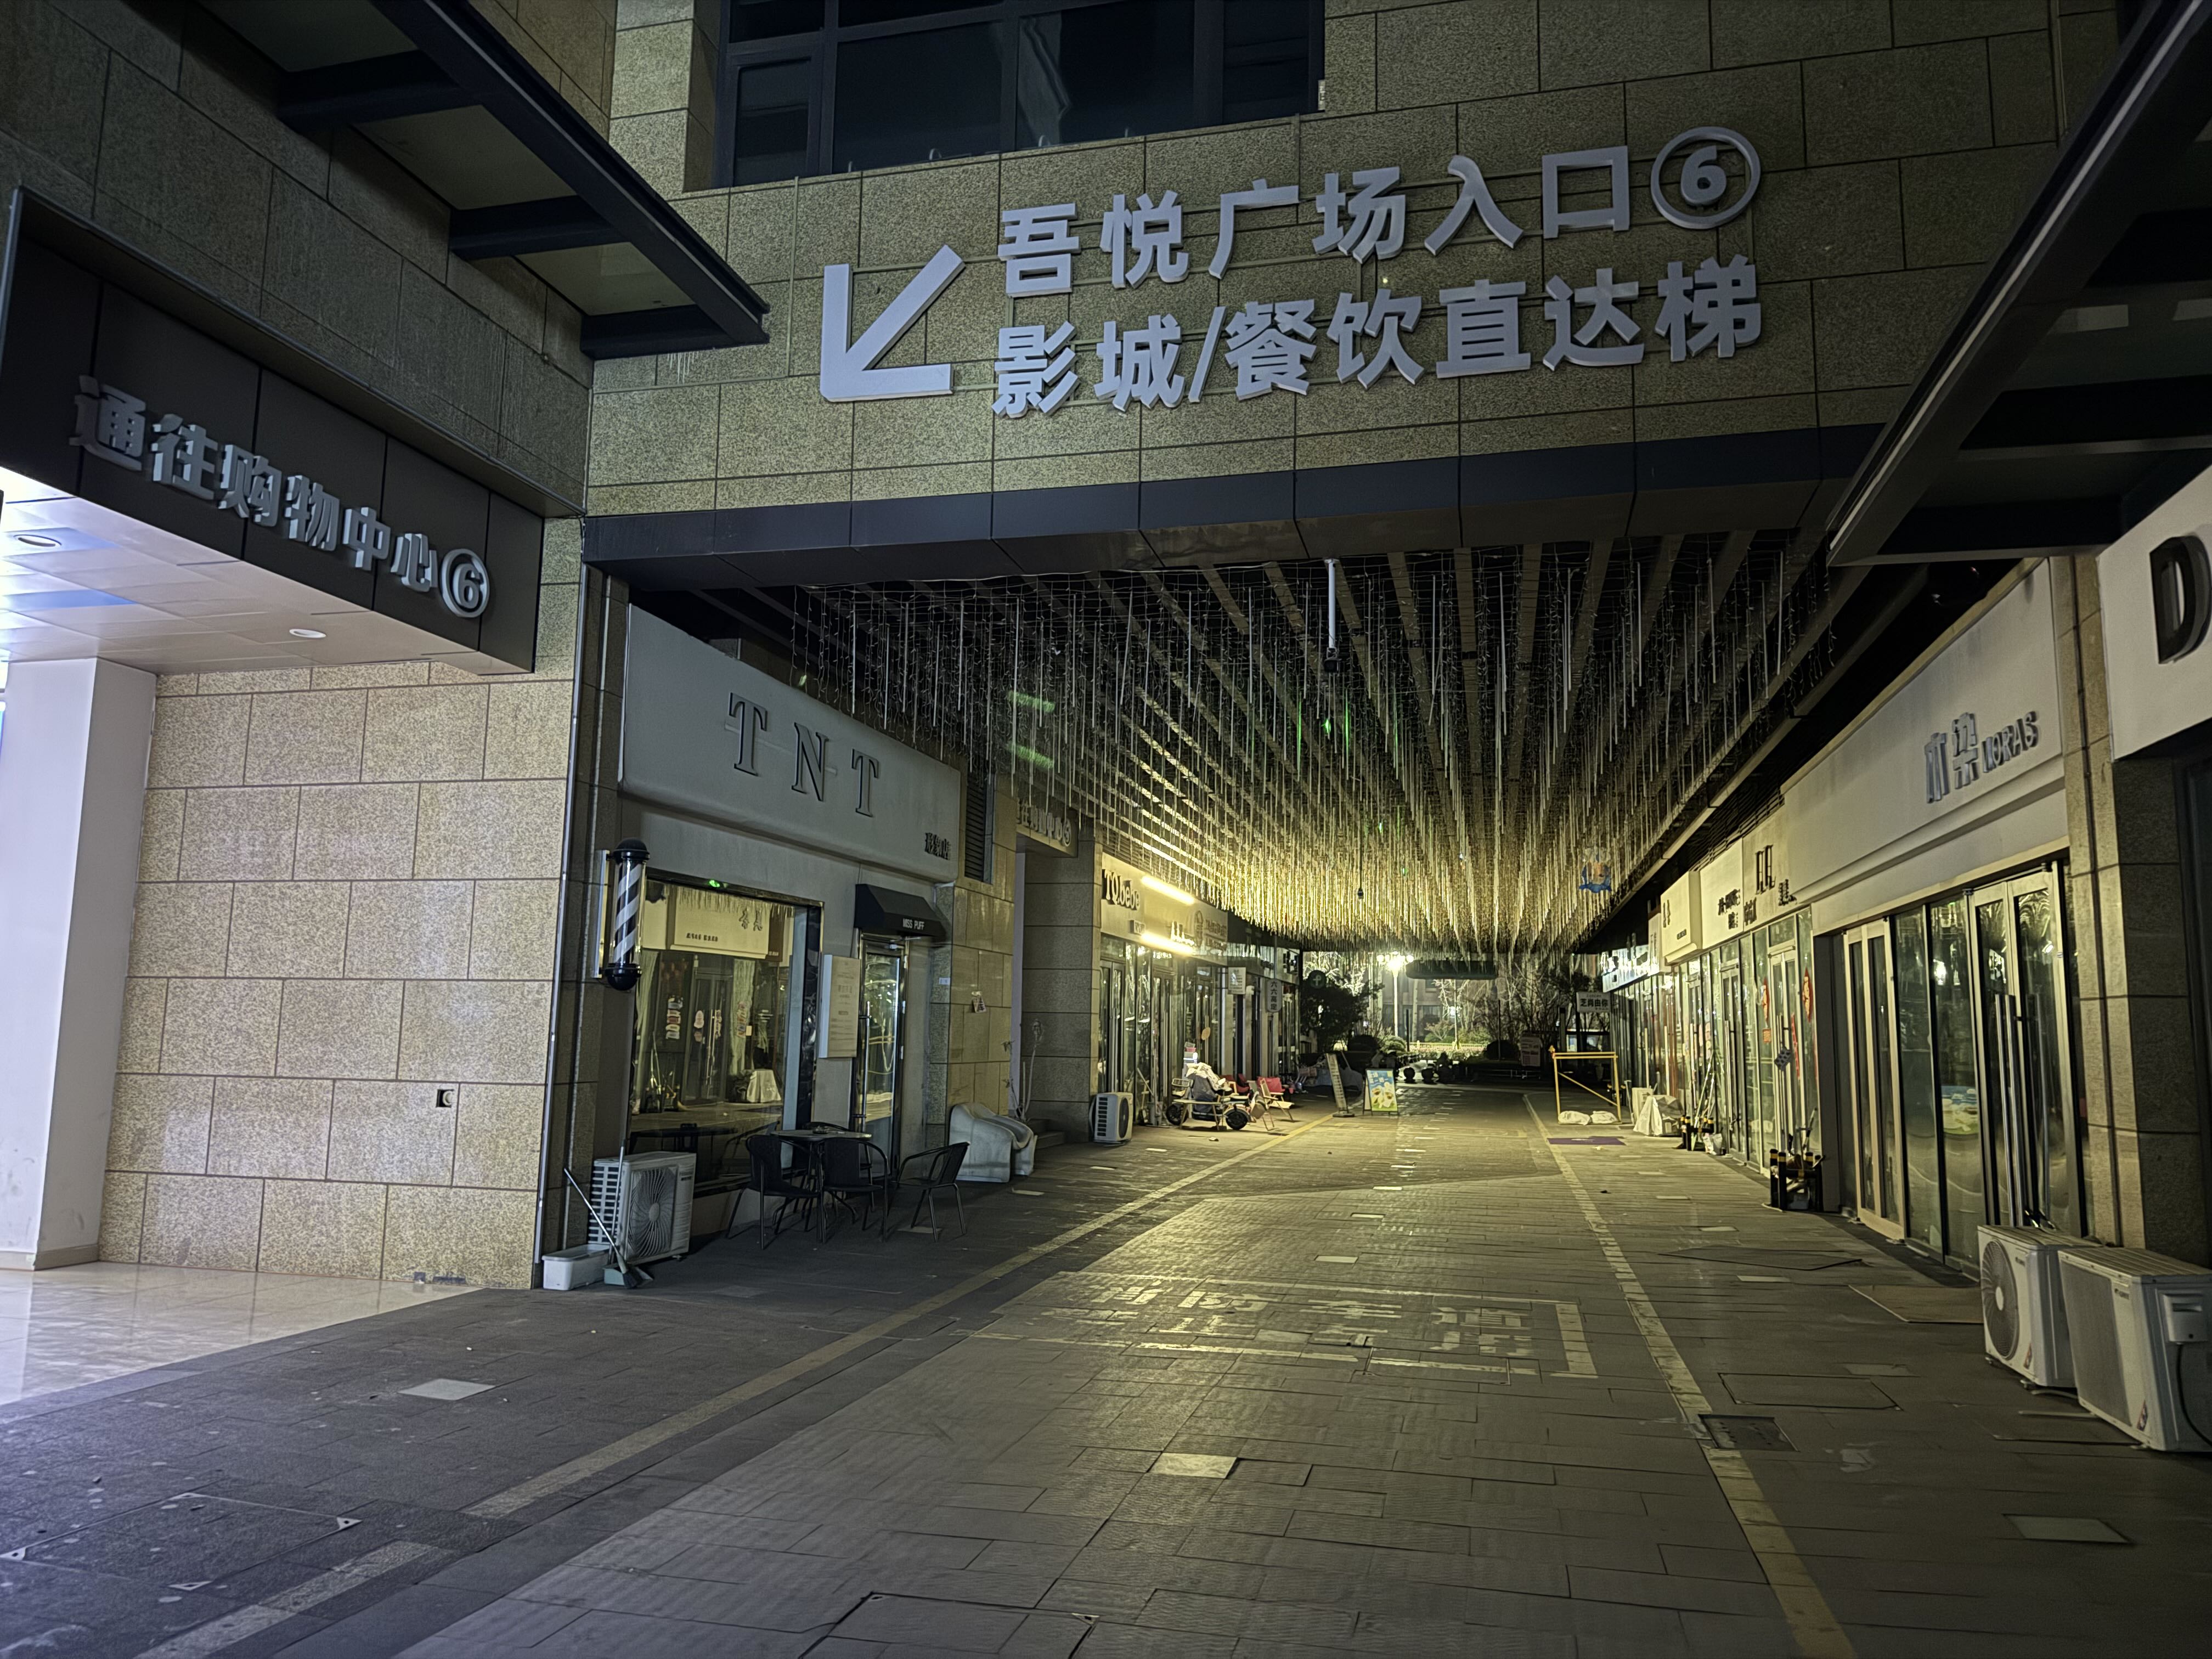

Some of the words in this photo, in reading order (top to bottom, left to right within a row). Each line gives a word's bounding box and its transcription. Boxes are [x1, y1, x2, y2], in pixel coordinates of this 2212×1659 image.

[992, 253, 1763, 419] 影城/餐饮直达梯
[729, 691, 879, 817] TNT
[913, 919, 925, 931] PUFF
